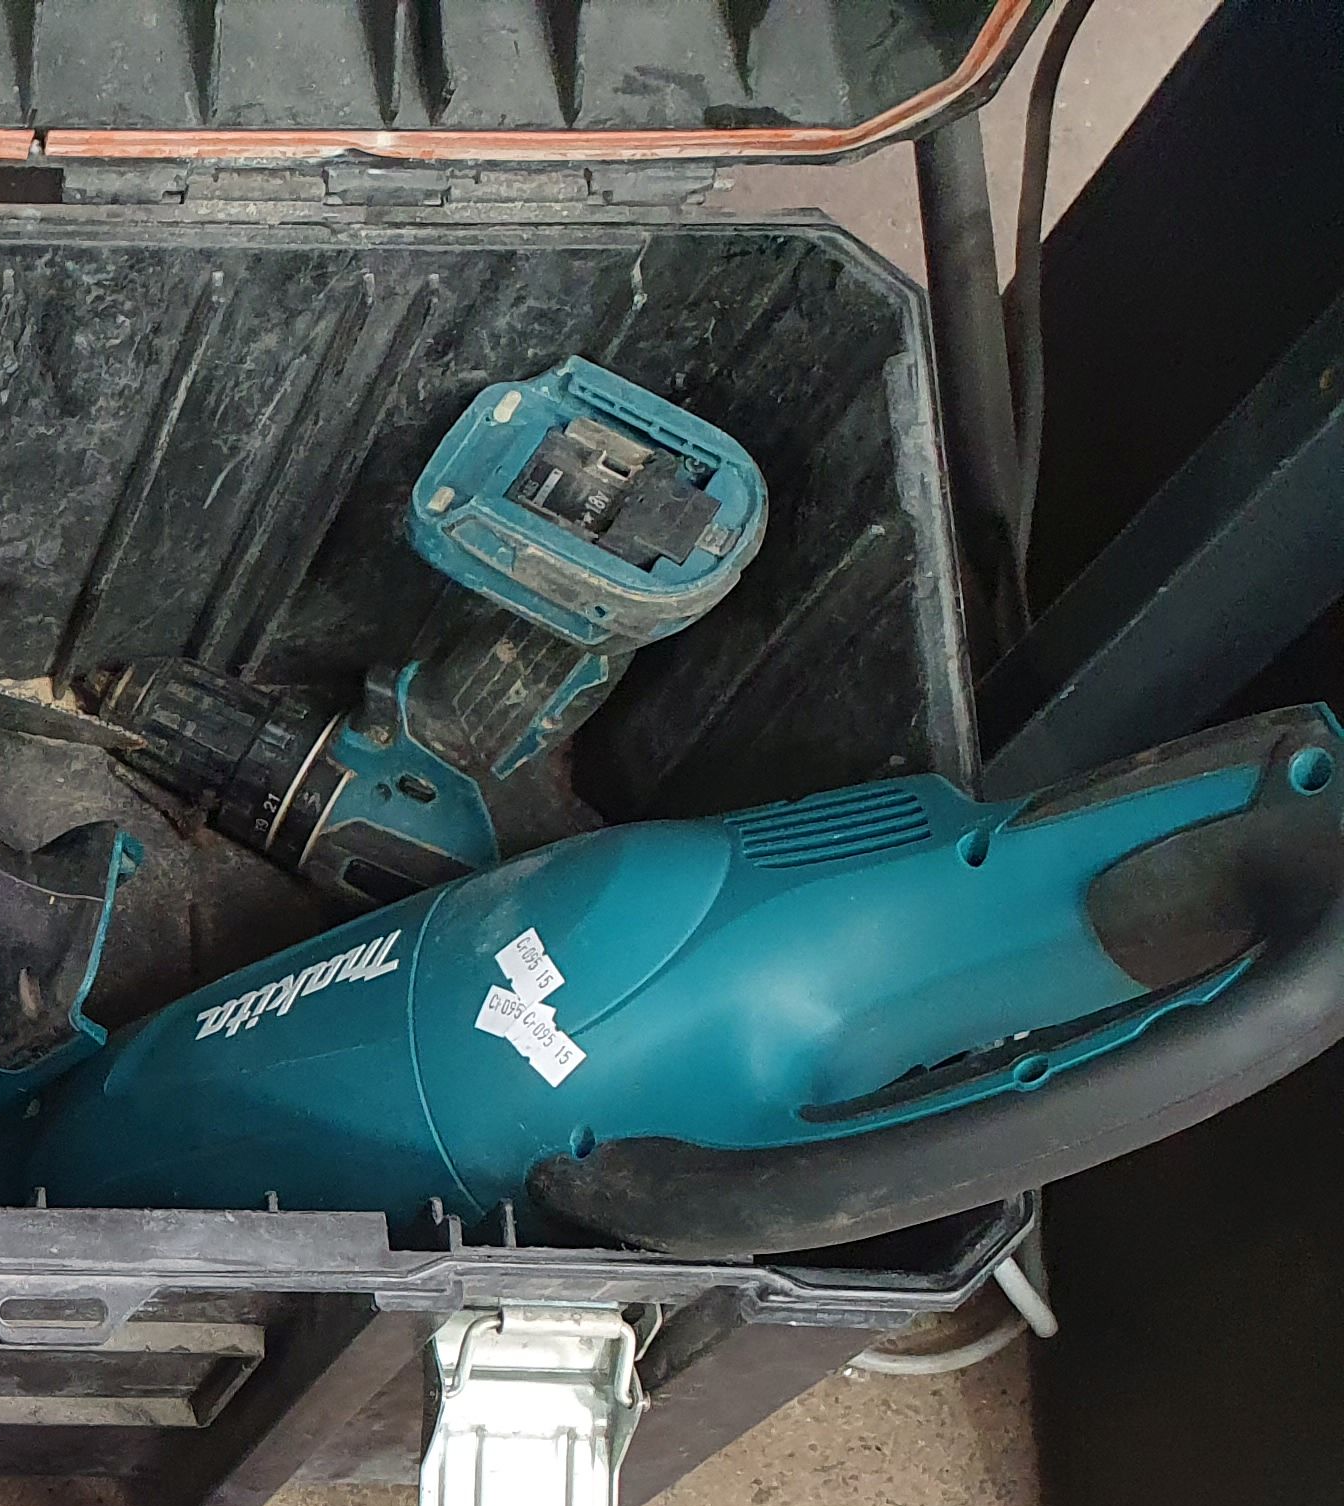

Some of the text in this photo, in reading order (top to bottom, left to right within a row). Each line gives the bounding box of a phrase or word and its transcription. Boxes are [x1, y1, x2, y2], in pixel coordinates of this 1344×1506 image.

[261, 791, 282, 814] 21
[193, 928, 400, 1043] makita
[534, 968, 554, 990] 15
[552, 1044, 574, 1065] 15
